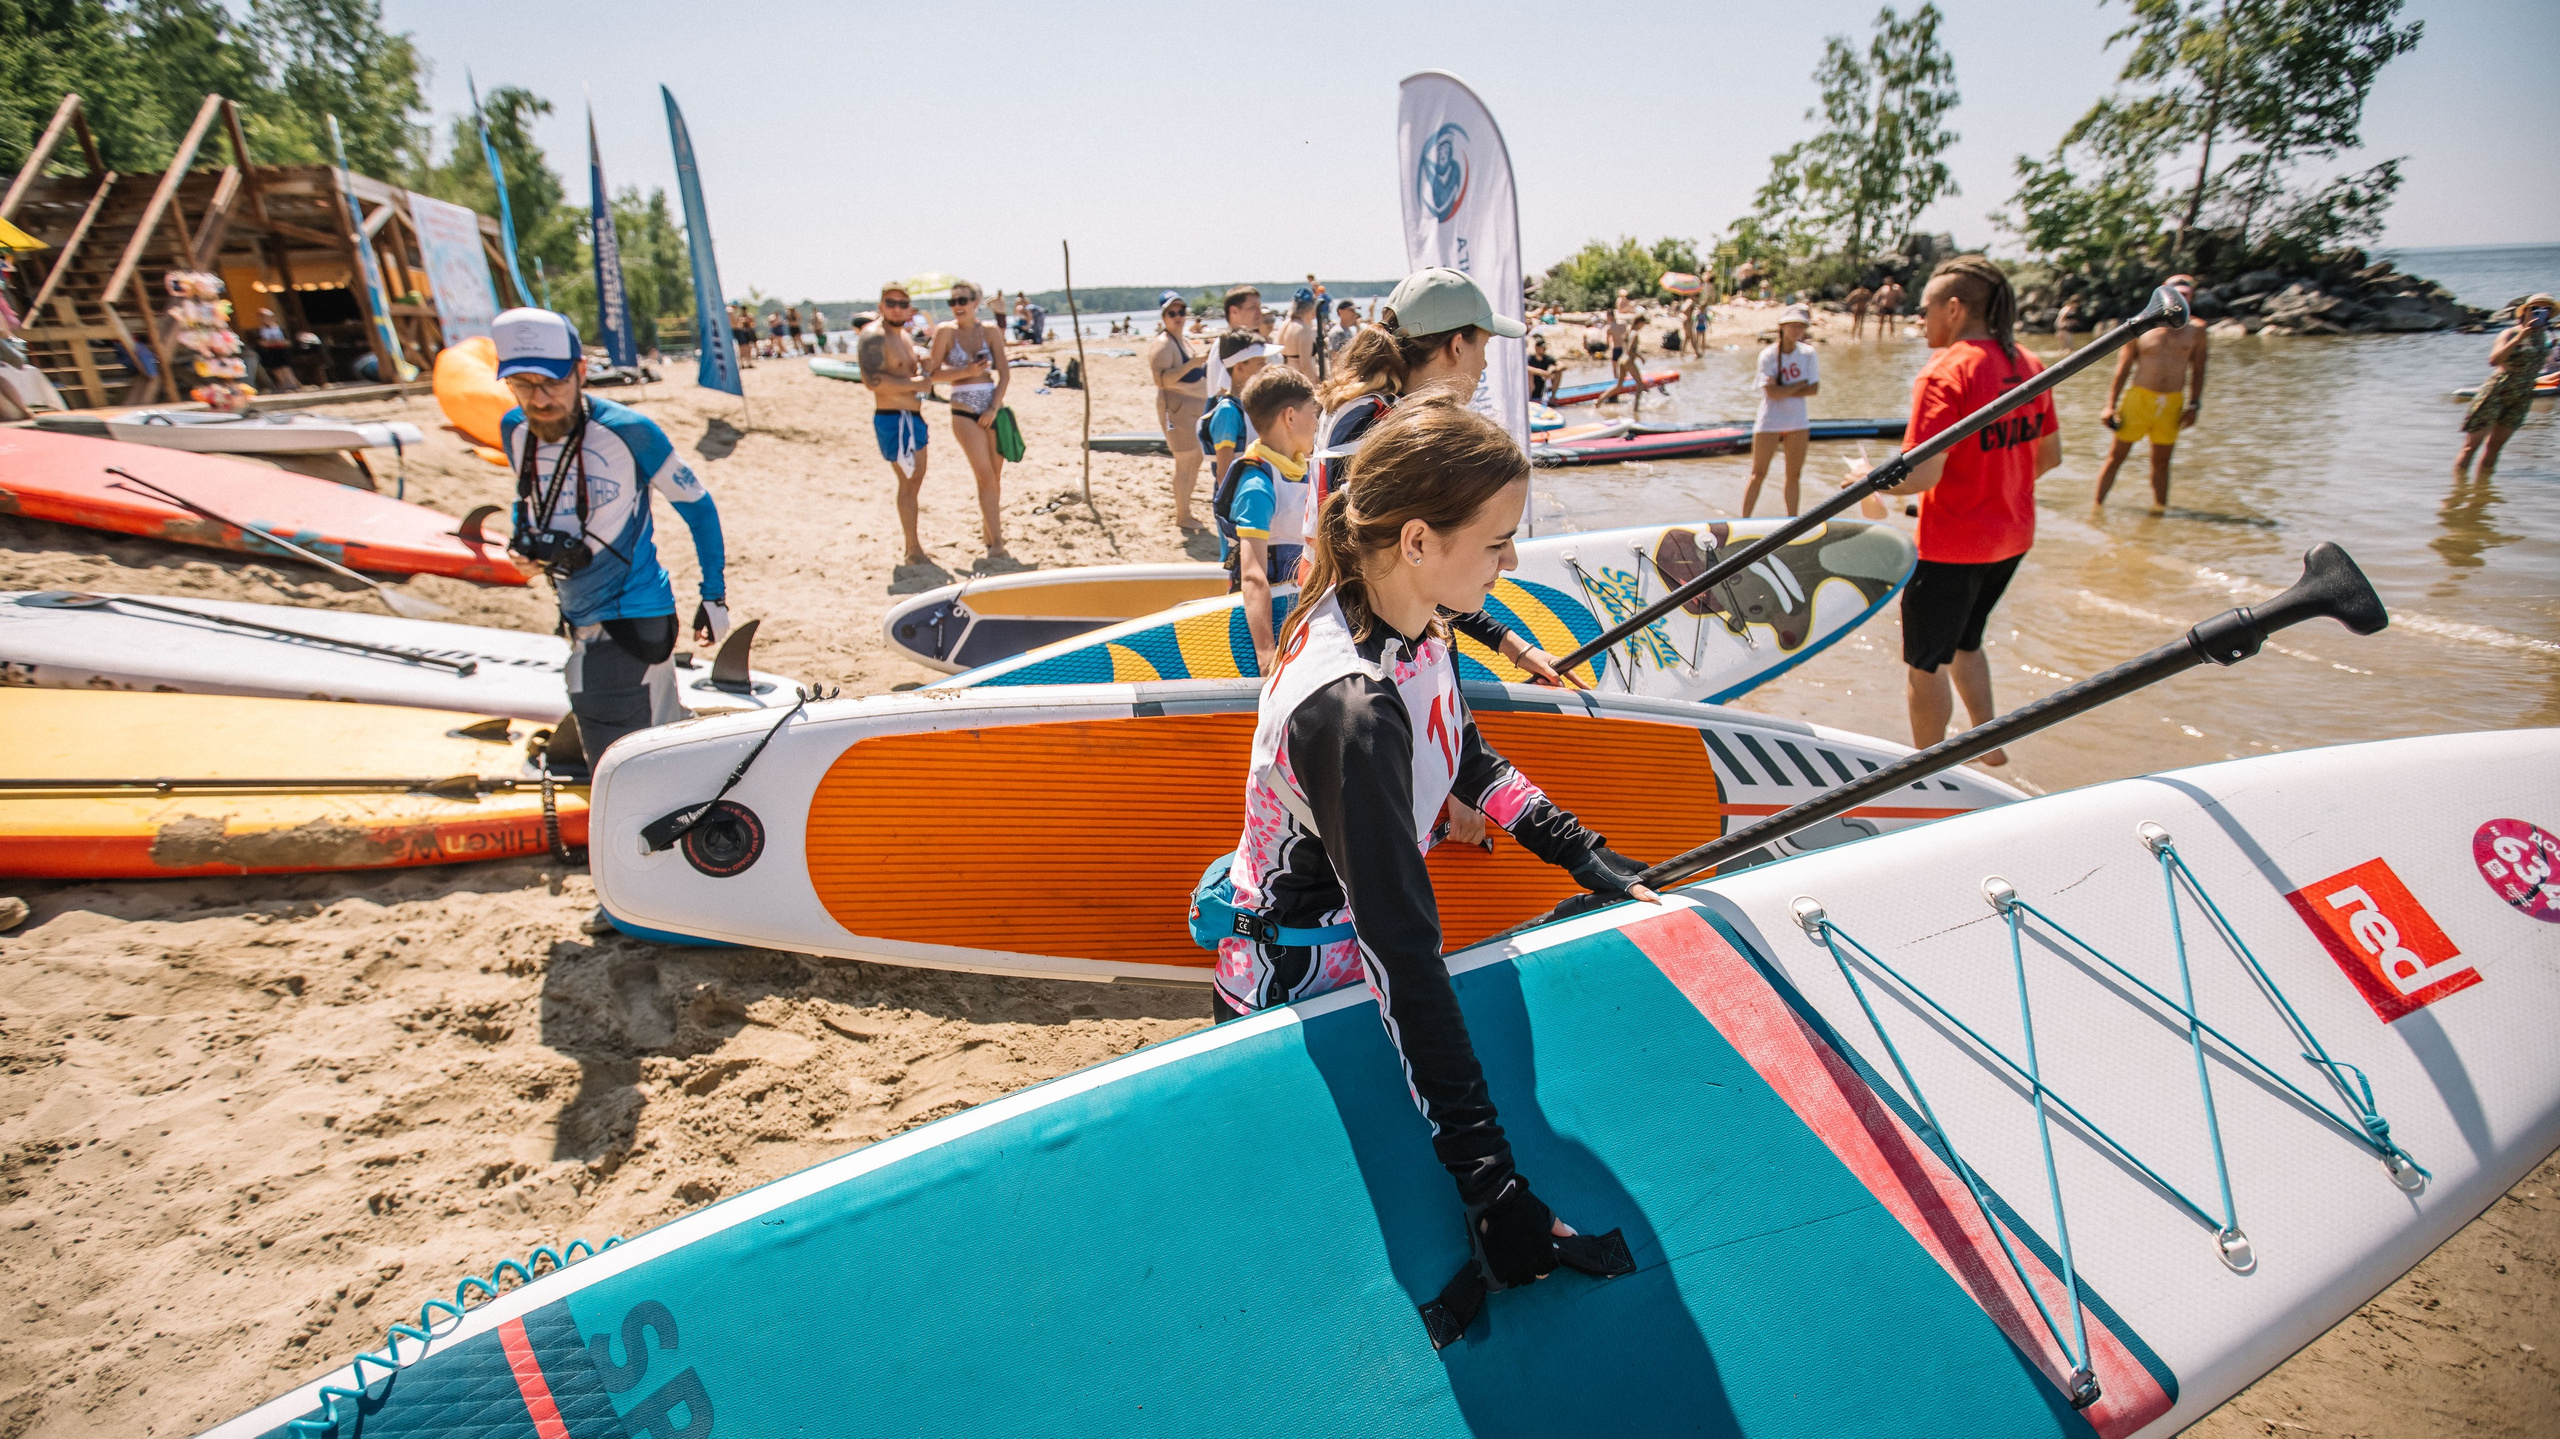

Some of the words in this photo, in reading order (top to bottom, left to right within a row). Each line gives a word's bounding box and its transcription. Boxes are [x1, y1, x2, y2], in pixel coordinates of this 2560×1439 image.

[1780, 362, 1801, 381] 16
[1584, 577, 1648, 656] Sibeia
[2325, 884, 2473, 996] red
